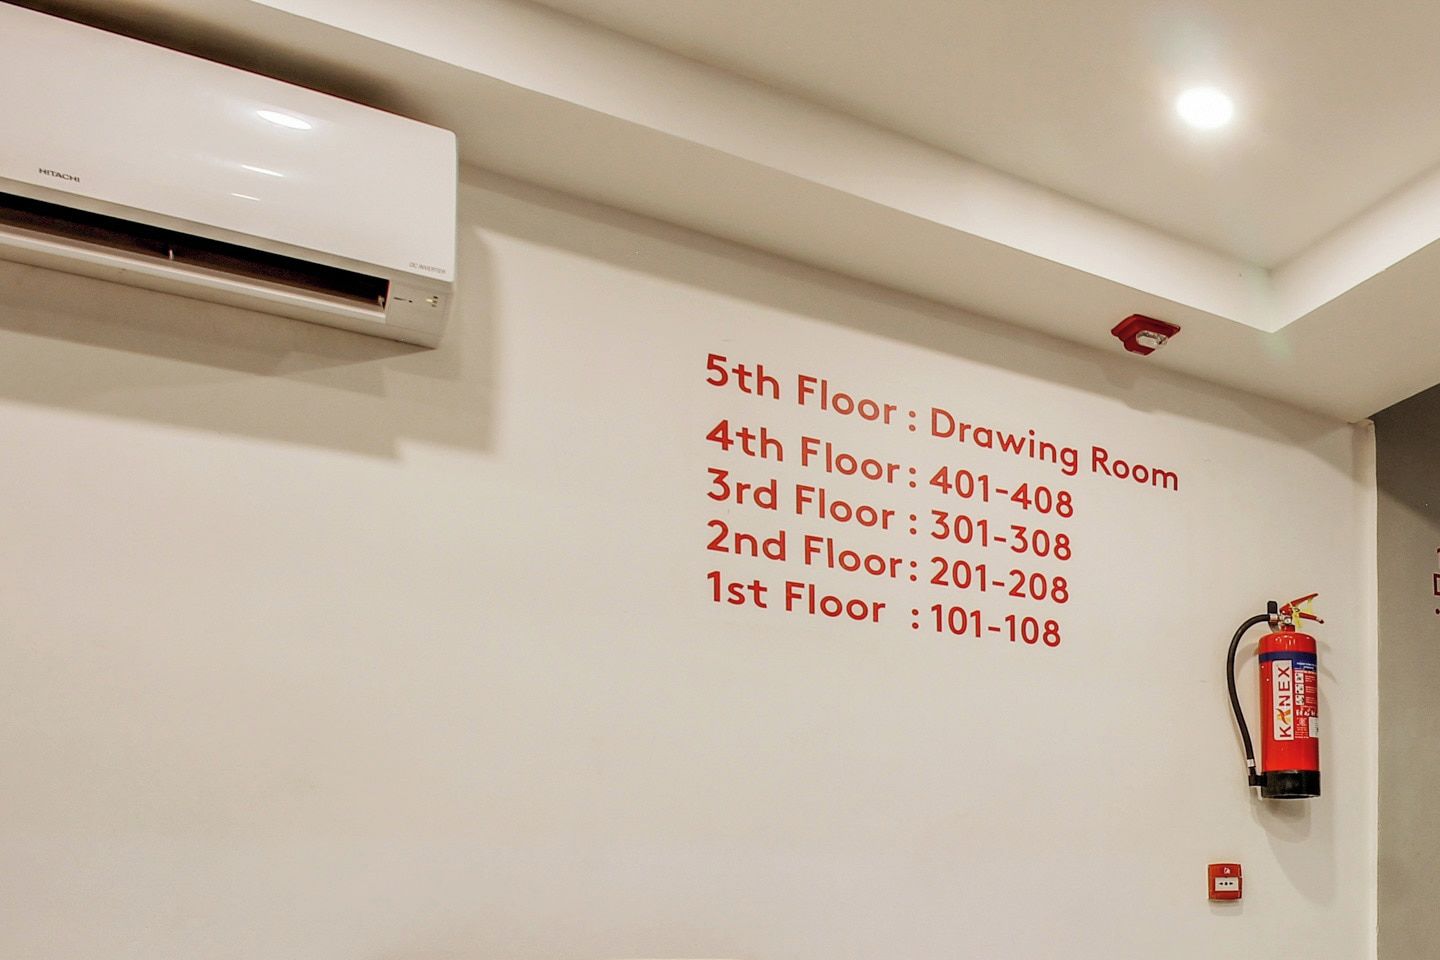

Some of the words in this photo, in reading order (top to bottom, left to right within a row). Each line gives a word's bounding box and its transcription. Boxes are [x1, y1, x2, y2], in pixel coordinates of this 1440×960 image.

[39, 168, 80, 182] HITACHI
[705, 353, 780, 400] 5th
[798, 374, 897, 424] Floor
[931, 408, 1079, 477] Drawing
[1091, 446, 1179, 491] Room
[706, 419, 784, 462] 4th
[801, 436, 900, 483] Floor
[929, 466, 1074, 519] 401-408
[707, 467, 778, 511] 3rd
[795, 484, 895, 529] Floor
[931, 510, 1072, 561] 301-308
[707, 519, 787, 561] 2nd
[804, 534, 903, 578] Floor
[930, 556, 1070, 605] 201-208
[707, 570, 768, 609] 1st
[785, 580, 886, 624] Floor
[930, 603, 1061, 649] 101-108
